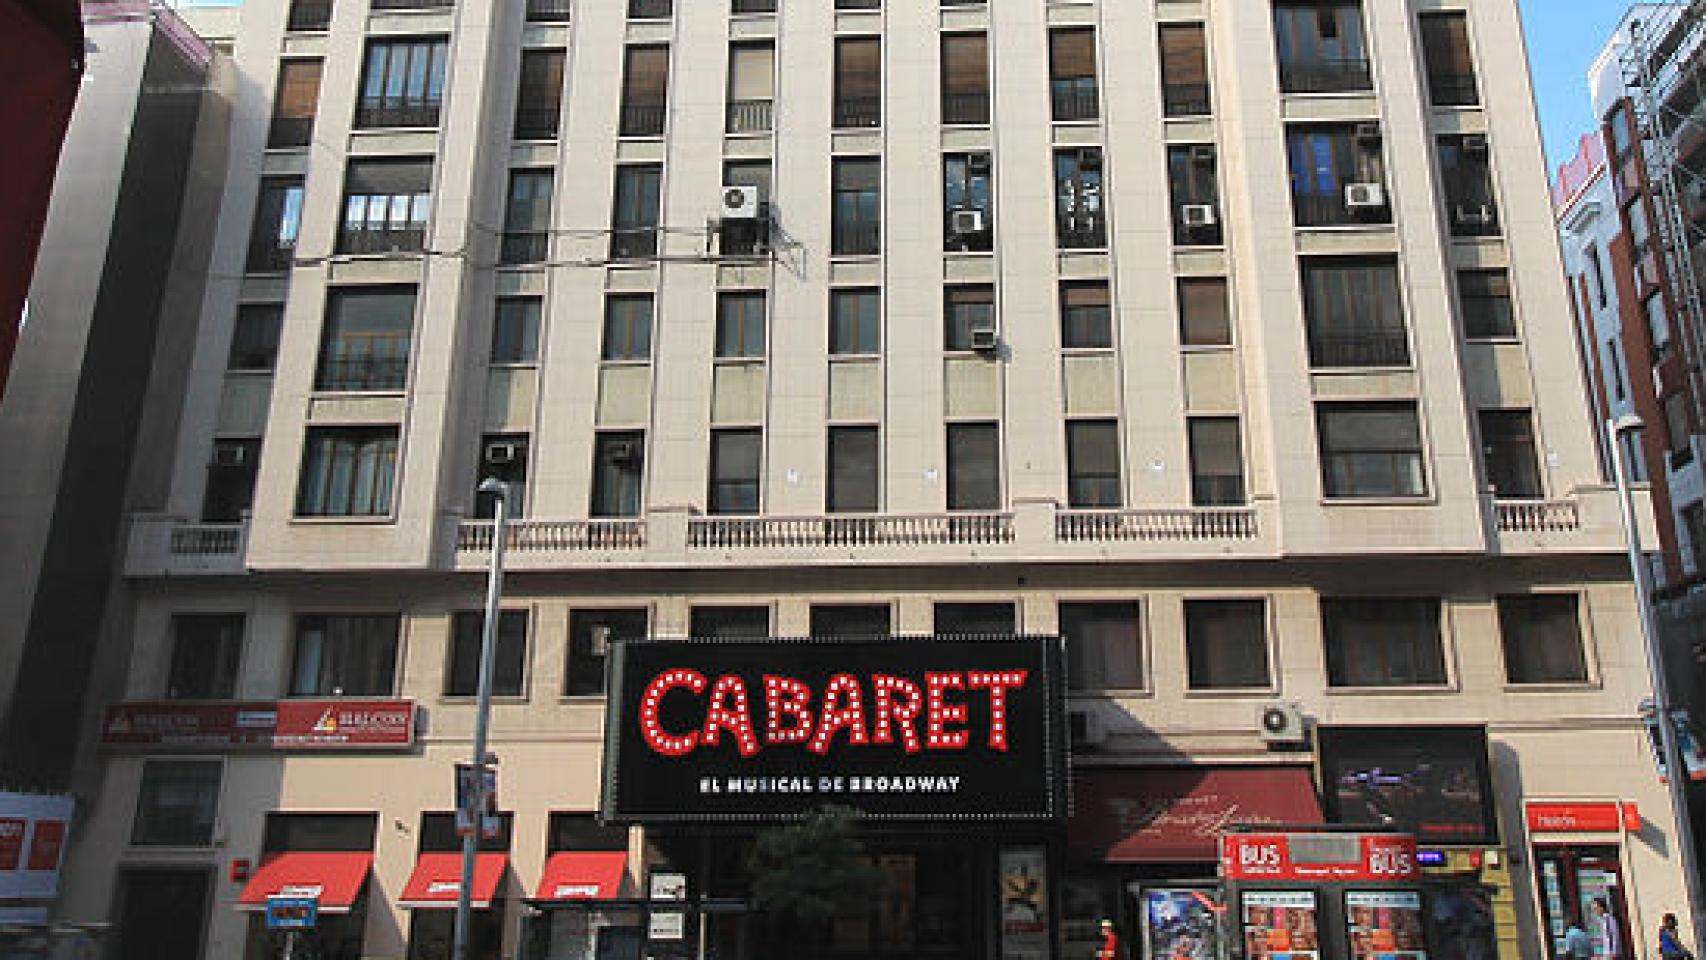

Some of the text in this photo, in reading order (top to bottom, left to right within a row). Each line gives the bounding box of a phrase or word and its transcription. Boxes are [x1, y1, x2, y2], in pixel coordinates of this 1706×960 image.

[639, 667, 1028, 757] CABARET
[699, 776, 960, 793] EL MUSICAL DE BROADWAY
[1240, 844, 1280, 865] BUS
[1370, 853, 1411, 874] BUS
